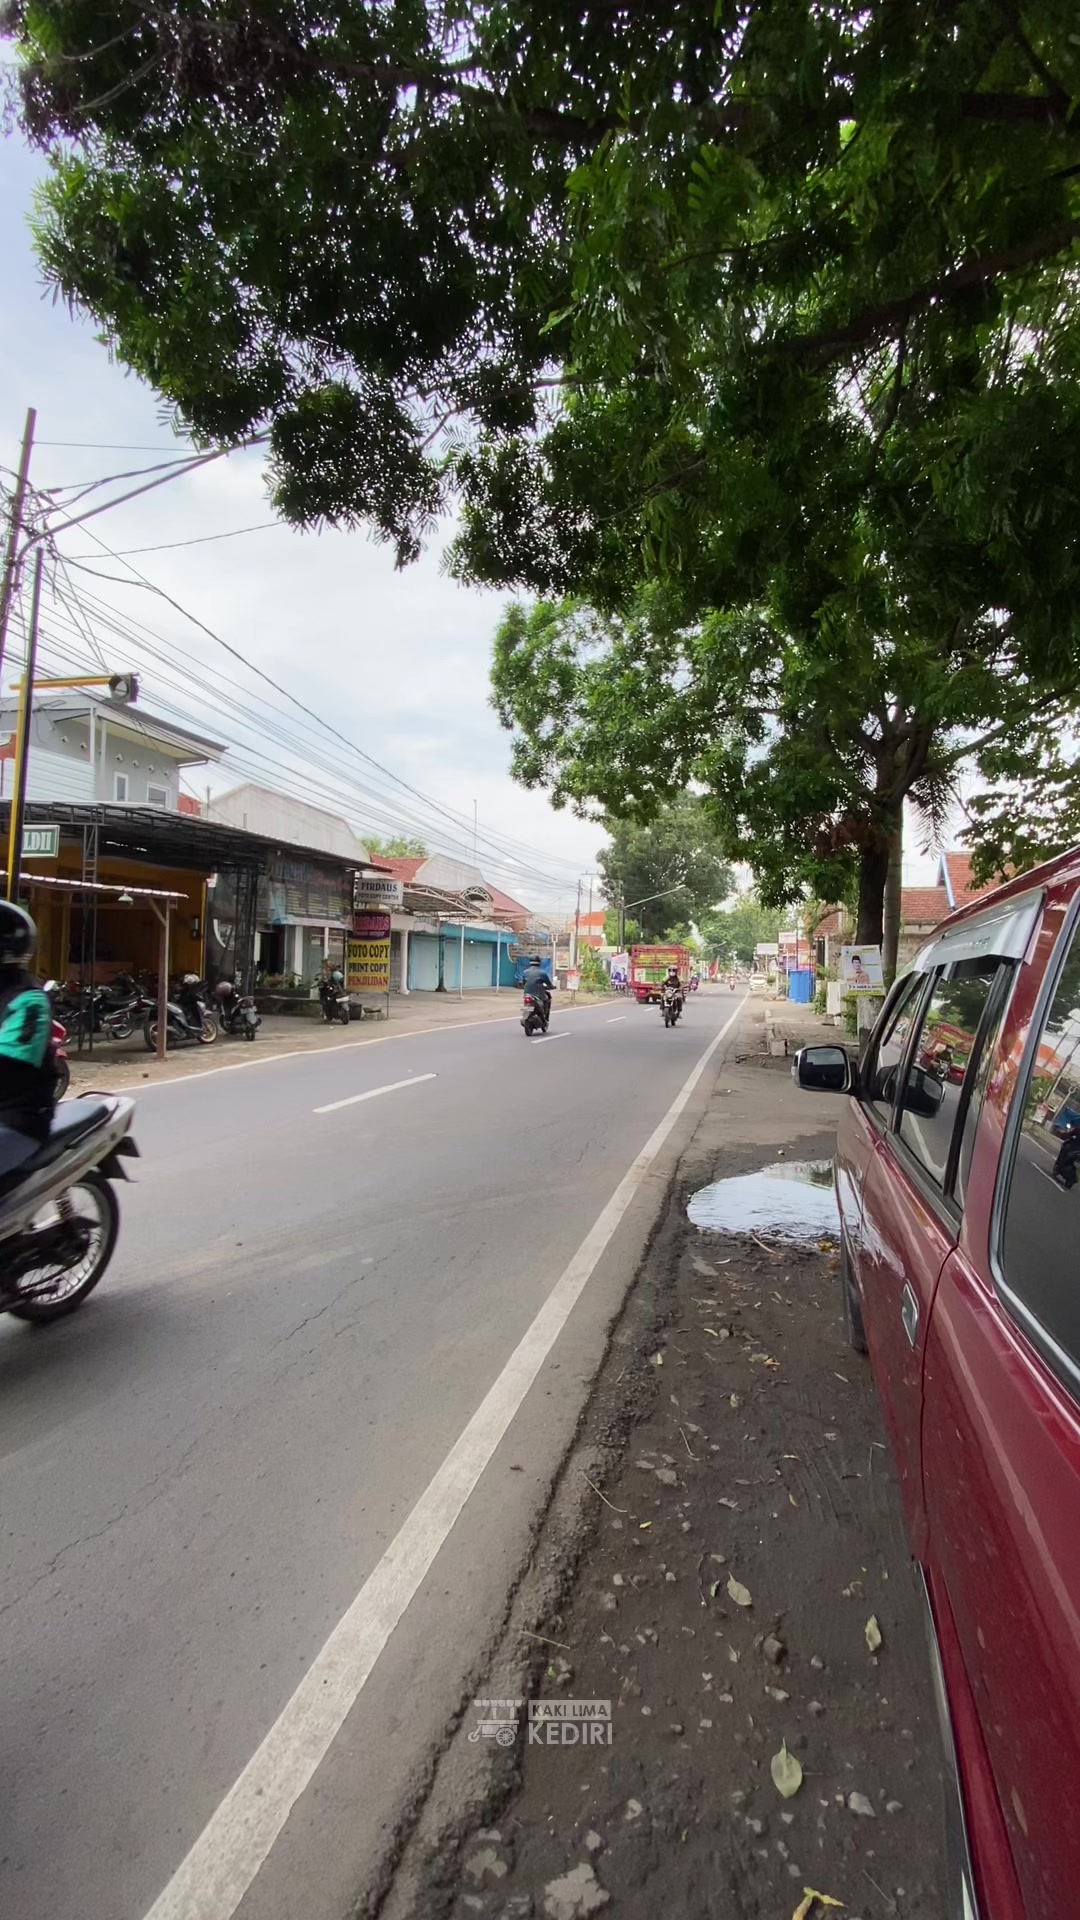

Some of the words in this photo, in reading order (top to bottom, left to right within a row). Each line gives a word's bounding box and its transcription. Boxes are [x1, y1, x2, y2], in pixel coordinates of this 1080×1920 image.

[361, 882, 398, 892] FIRDAUS
[348, 944, 368, 958] FOTO
[369, 944, 389, 958] COPY
[349, 962, 369, 973] PRINT
[370, 963, 388, 973] COPY
